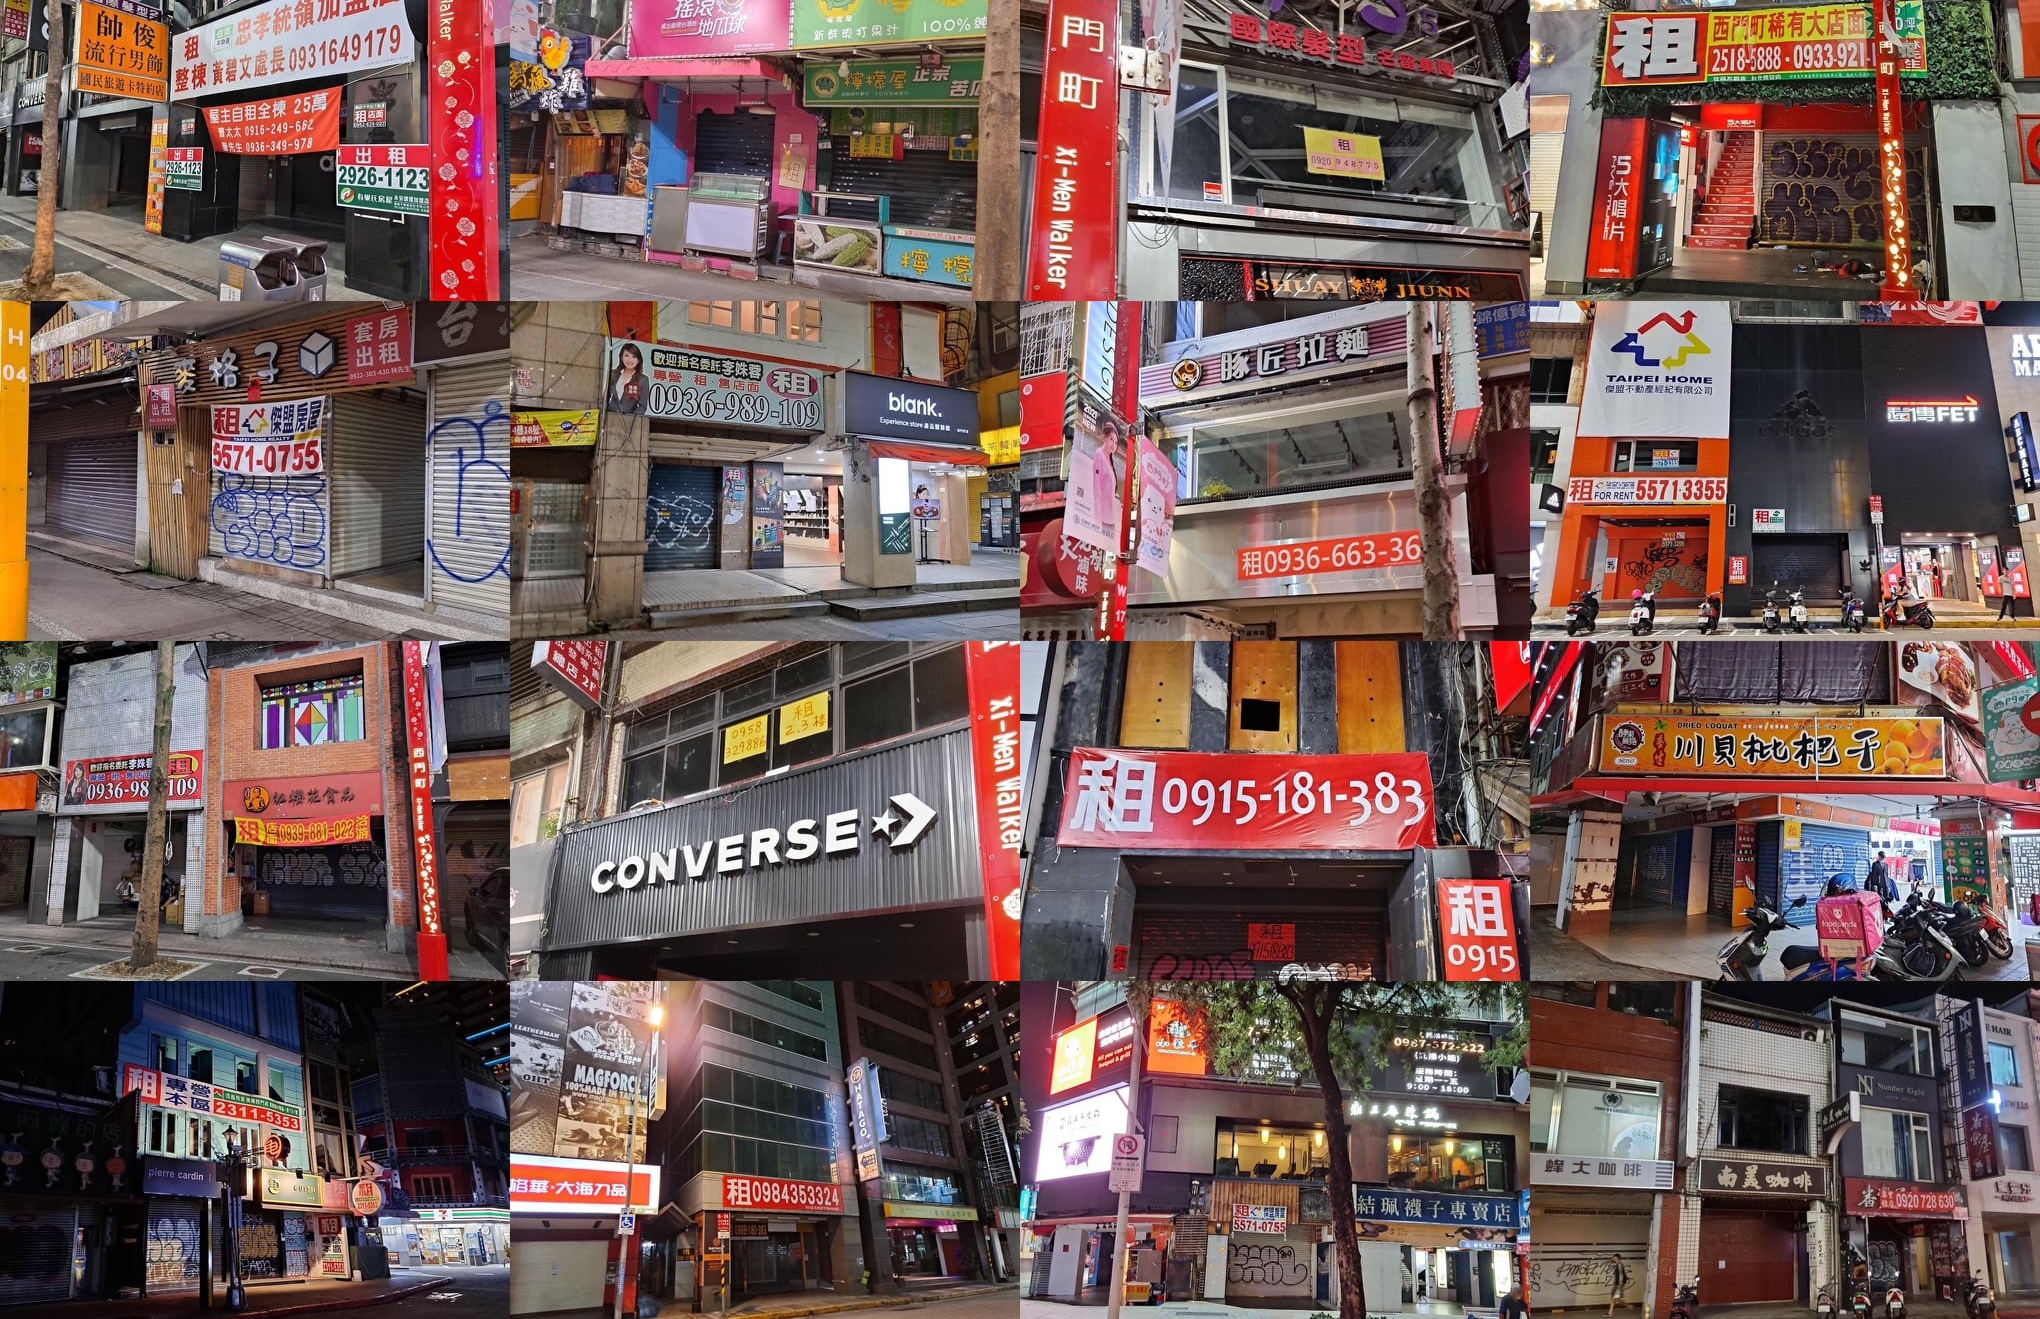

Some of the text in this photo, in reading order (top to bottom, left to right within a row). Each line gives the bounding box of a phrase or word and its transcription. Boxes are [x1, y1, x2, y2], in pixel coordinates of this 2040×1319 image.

[97, 11, 156, 50] 帥俊
[699, 15, 747, 38] 地瓜球
[814, 18, 970, 41] 新鮮現打果汁 100%
[1713, 10, 1864, 42] 西門町稀有大店面
[184, 35, 199, 62] 租
[212, 25, 401, 85] 黃碧文處長 0931649179
[1231, 12, 1456, 78] 國際髮型 名留集團
[1612, 17, 1697, 78] 租
[85, 39, 163, 75] 流行男飾
[1059, 15, 1104, 109] 門町
[80, 72, 164, 97] 國民旅遊卡特約店
[175, 62, 207, 93] 整棟
[844, 70, 907, 90] 檸檬屋
[912, 65, 951, 83] 正宗
[18, 93, 46, 109] CONVERS
[209, 92, 329, 123] 屋主自租全棟 25萬
[354, 109, 384, 123] 租 店面
[174, 149, 194, 160] 出租
[1337, 138, 1351, 151] 租
[356, 147, 407, 165] 出租
[1311, 155, 1332, 166] 0920
[166, 161, 202, 175] 2926-1123
[338, 166, 429, 190] 2926-1123
[782, 161, 801, 184] 租
[1608, 155, 1632, 242] 5大唱片
[1047, 145, 1077, 290] Xi-Men Walker
[1255, 278, 1471, 299] SHUAY JIUNN
[8, 328, 24, 346] H
[354, 315, 400, 343] 套房
[356, 342, 401, 368] 出租
[1220, 326, 1369, 384] 豚匠拉麵
[3, 364, 27, 383] 04
[772, 371, 813, 397] 租
[1606, 375, 1713, 384] TAIPEI HOME
[1605, 385, 1713, 396] 傑盟不動產經紀有限公司
[152, 402, 171, 416] 出租
[650, 383, 820, 427] 0936-989-109
[889, 391, 943, 418] blank.
[213, 407, 241, 435] 租
[880, 417, 923, 429] Experience store
[213, 440, 320, 474] 5571-0755
[727, 469, 742, 480] 租
[1569, 479, 1594, 501] 租
[1594, 491, 1635, 500] FOR RENT
[1755, 510, 1770, 524] 租
[1117, 584, 1127, 598] W
[1115, 611, 1126, 623] 17
[582, 675, 597, 693] 2F
[794, 701, 814, 721] 租
[731, 721, 763, 738] 0958
[988, 696, 1015, 773] Xi-Men
[1677, 722, 1702, 730] DRIED
[1705, 722, 1738, 730] LOQUAT
[1069, 759, 1426, 833] 租 0915-181-383
[1787, 825, 1798, 837] 租
[590, 808, 861, 894] CONVERSE
[1448, 885, 1507, 937] 租
[1260, 924, 1283, 941] 租
[1822, 919, 1858, 929] foodpanda
[1448, 944, 1517, 973] 0915
[514, 1023, 560, 1040] LEATHERMAN
[128, 1068, 211, 1099] 租 專營
[1406, 1082, 1469, 1094] 9:00 18:00
[1878, 1082, 1925, 1097] Number Eight
[164, 1092, 211, 1113] 本區
[215, 1101, 299, 1130] 2311-5353
[148, 1168, 204, 1182] pierre cardin
[1545, 1159, 1642, 1178] 蜂大咖啡
[1717, 1165, 1813, 1192] 南美咖啡
[1357, 1195, 1511, 1223] 結珮襪子專賣店
[1233, 1217, 1287, 1234] 5571-0755
